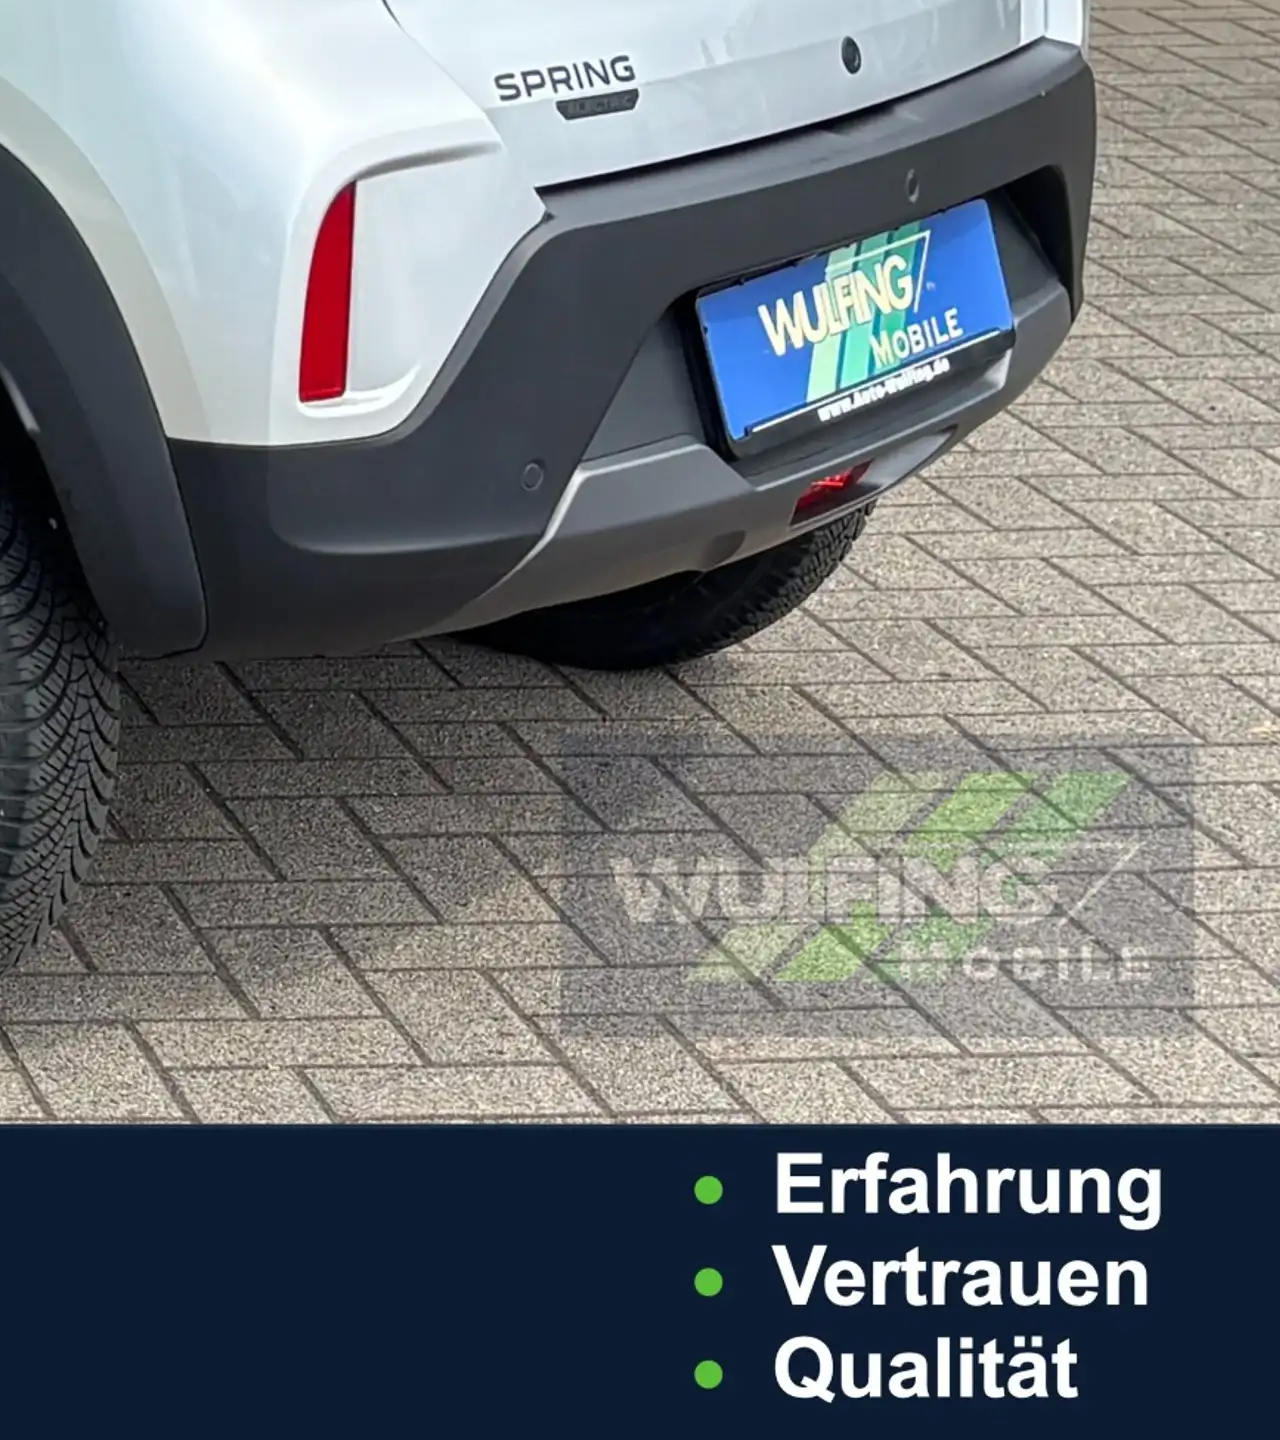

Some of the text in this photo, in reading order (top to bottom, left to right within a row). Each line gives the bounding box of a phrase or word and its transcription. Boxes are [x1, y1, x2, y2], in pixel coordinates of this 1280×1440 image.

[494, 54, 636, 102] SPRING
[757, 253, 914, 357] WULFING
[868, 307, 964, 371] MOBILE
